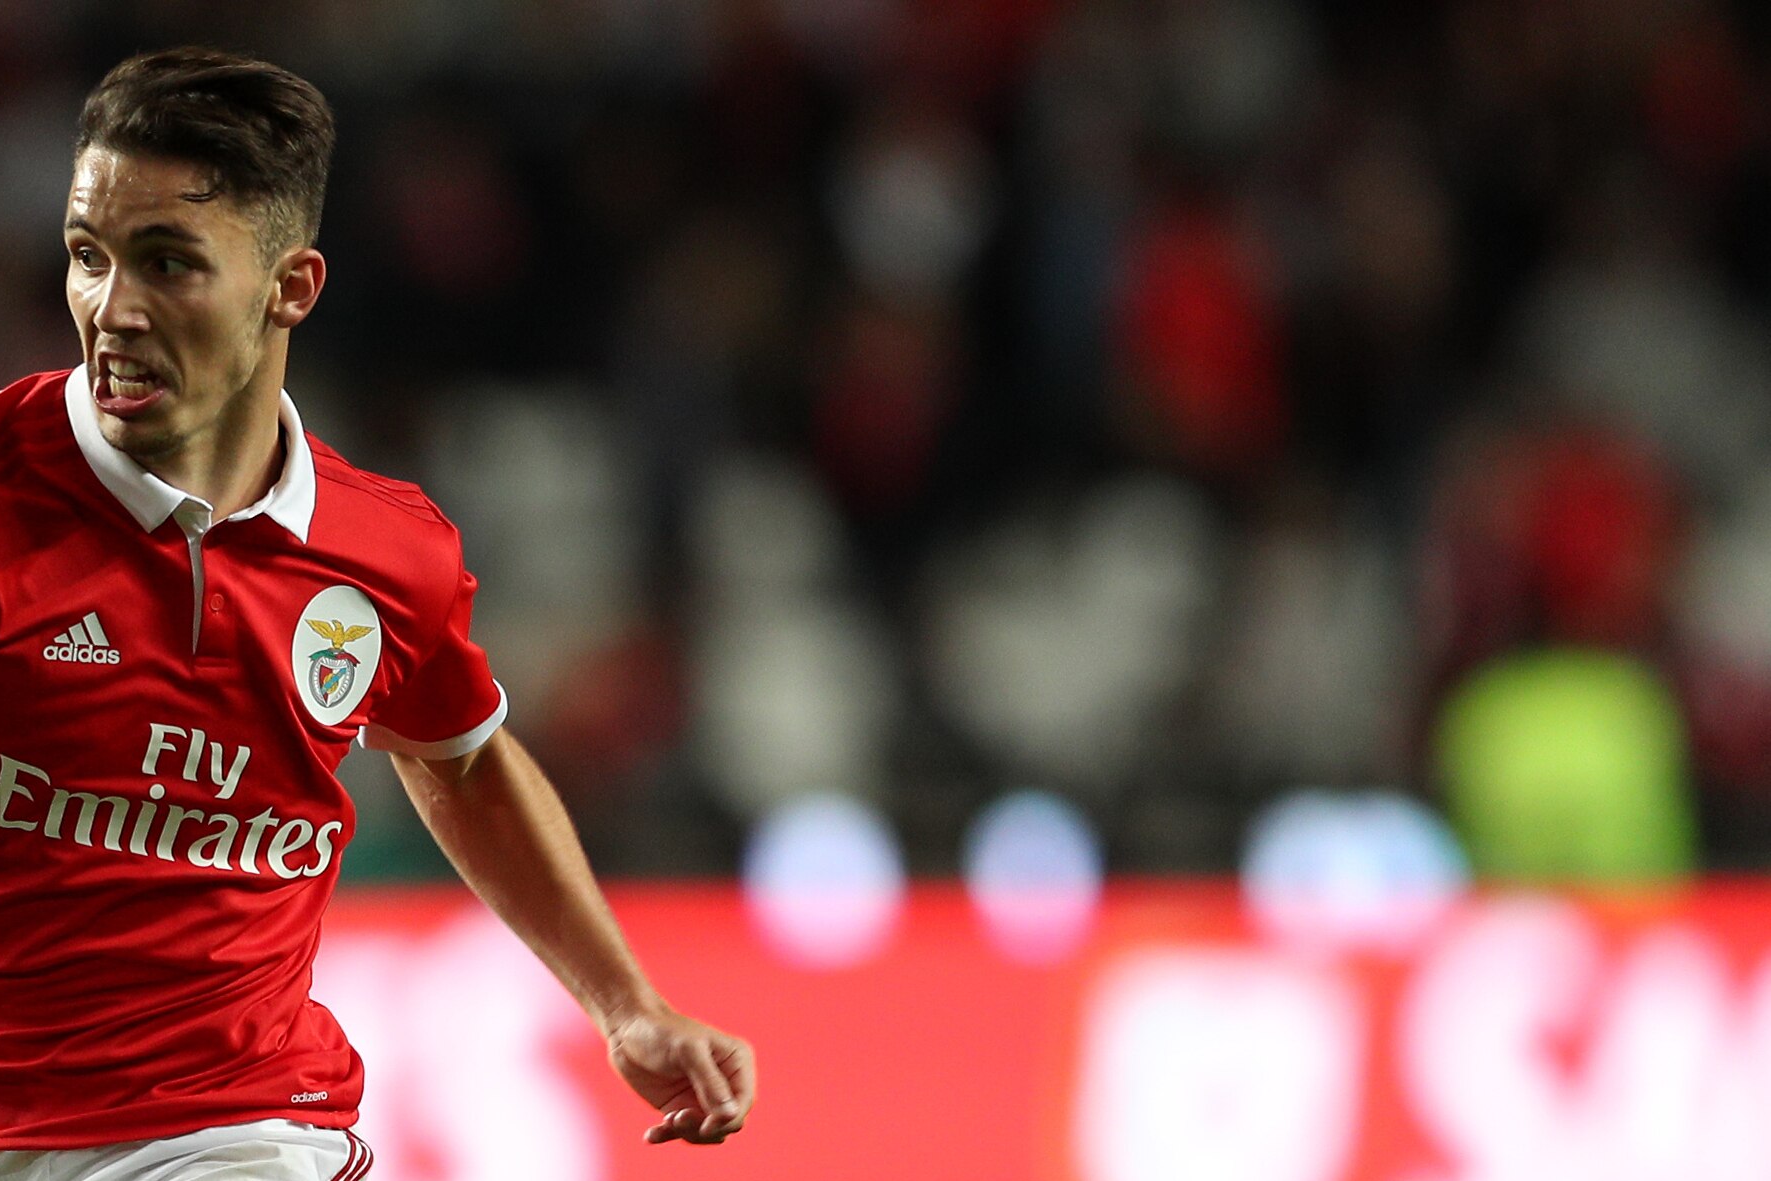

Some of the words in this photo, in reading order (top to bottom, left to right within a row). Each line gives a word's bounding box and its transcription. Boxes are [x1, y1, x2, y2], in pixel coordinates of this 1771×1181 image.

[43, 644, 121, 666] adidas
[141, 722, 251, 800] Fly
[291, 1091, 328, 1103] adizero
